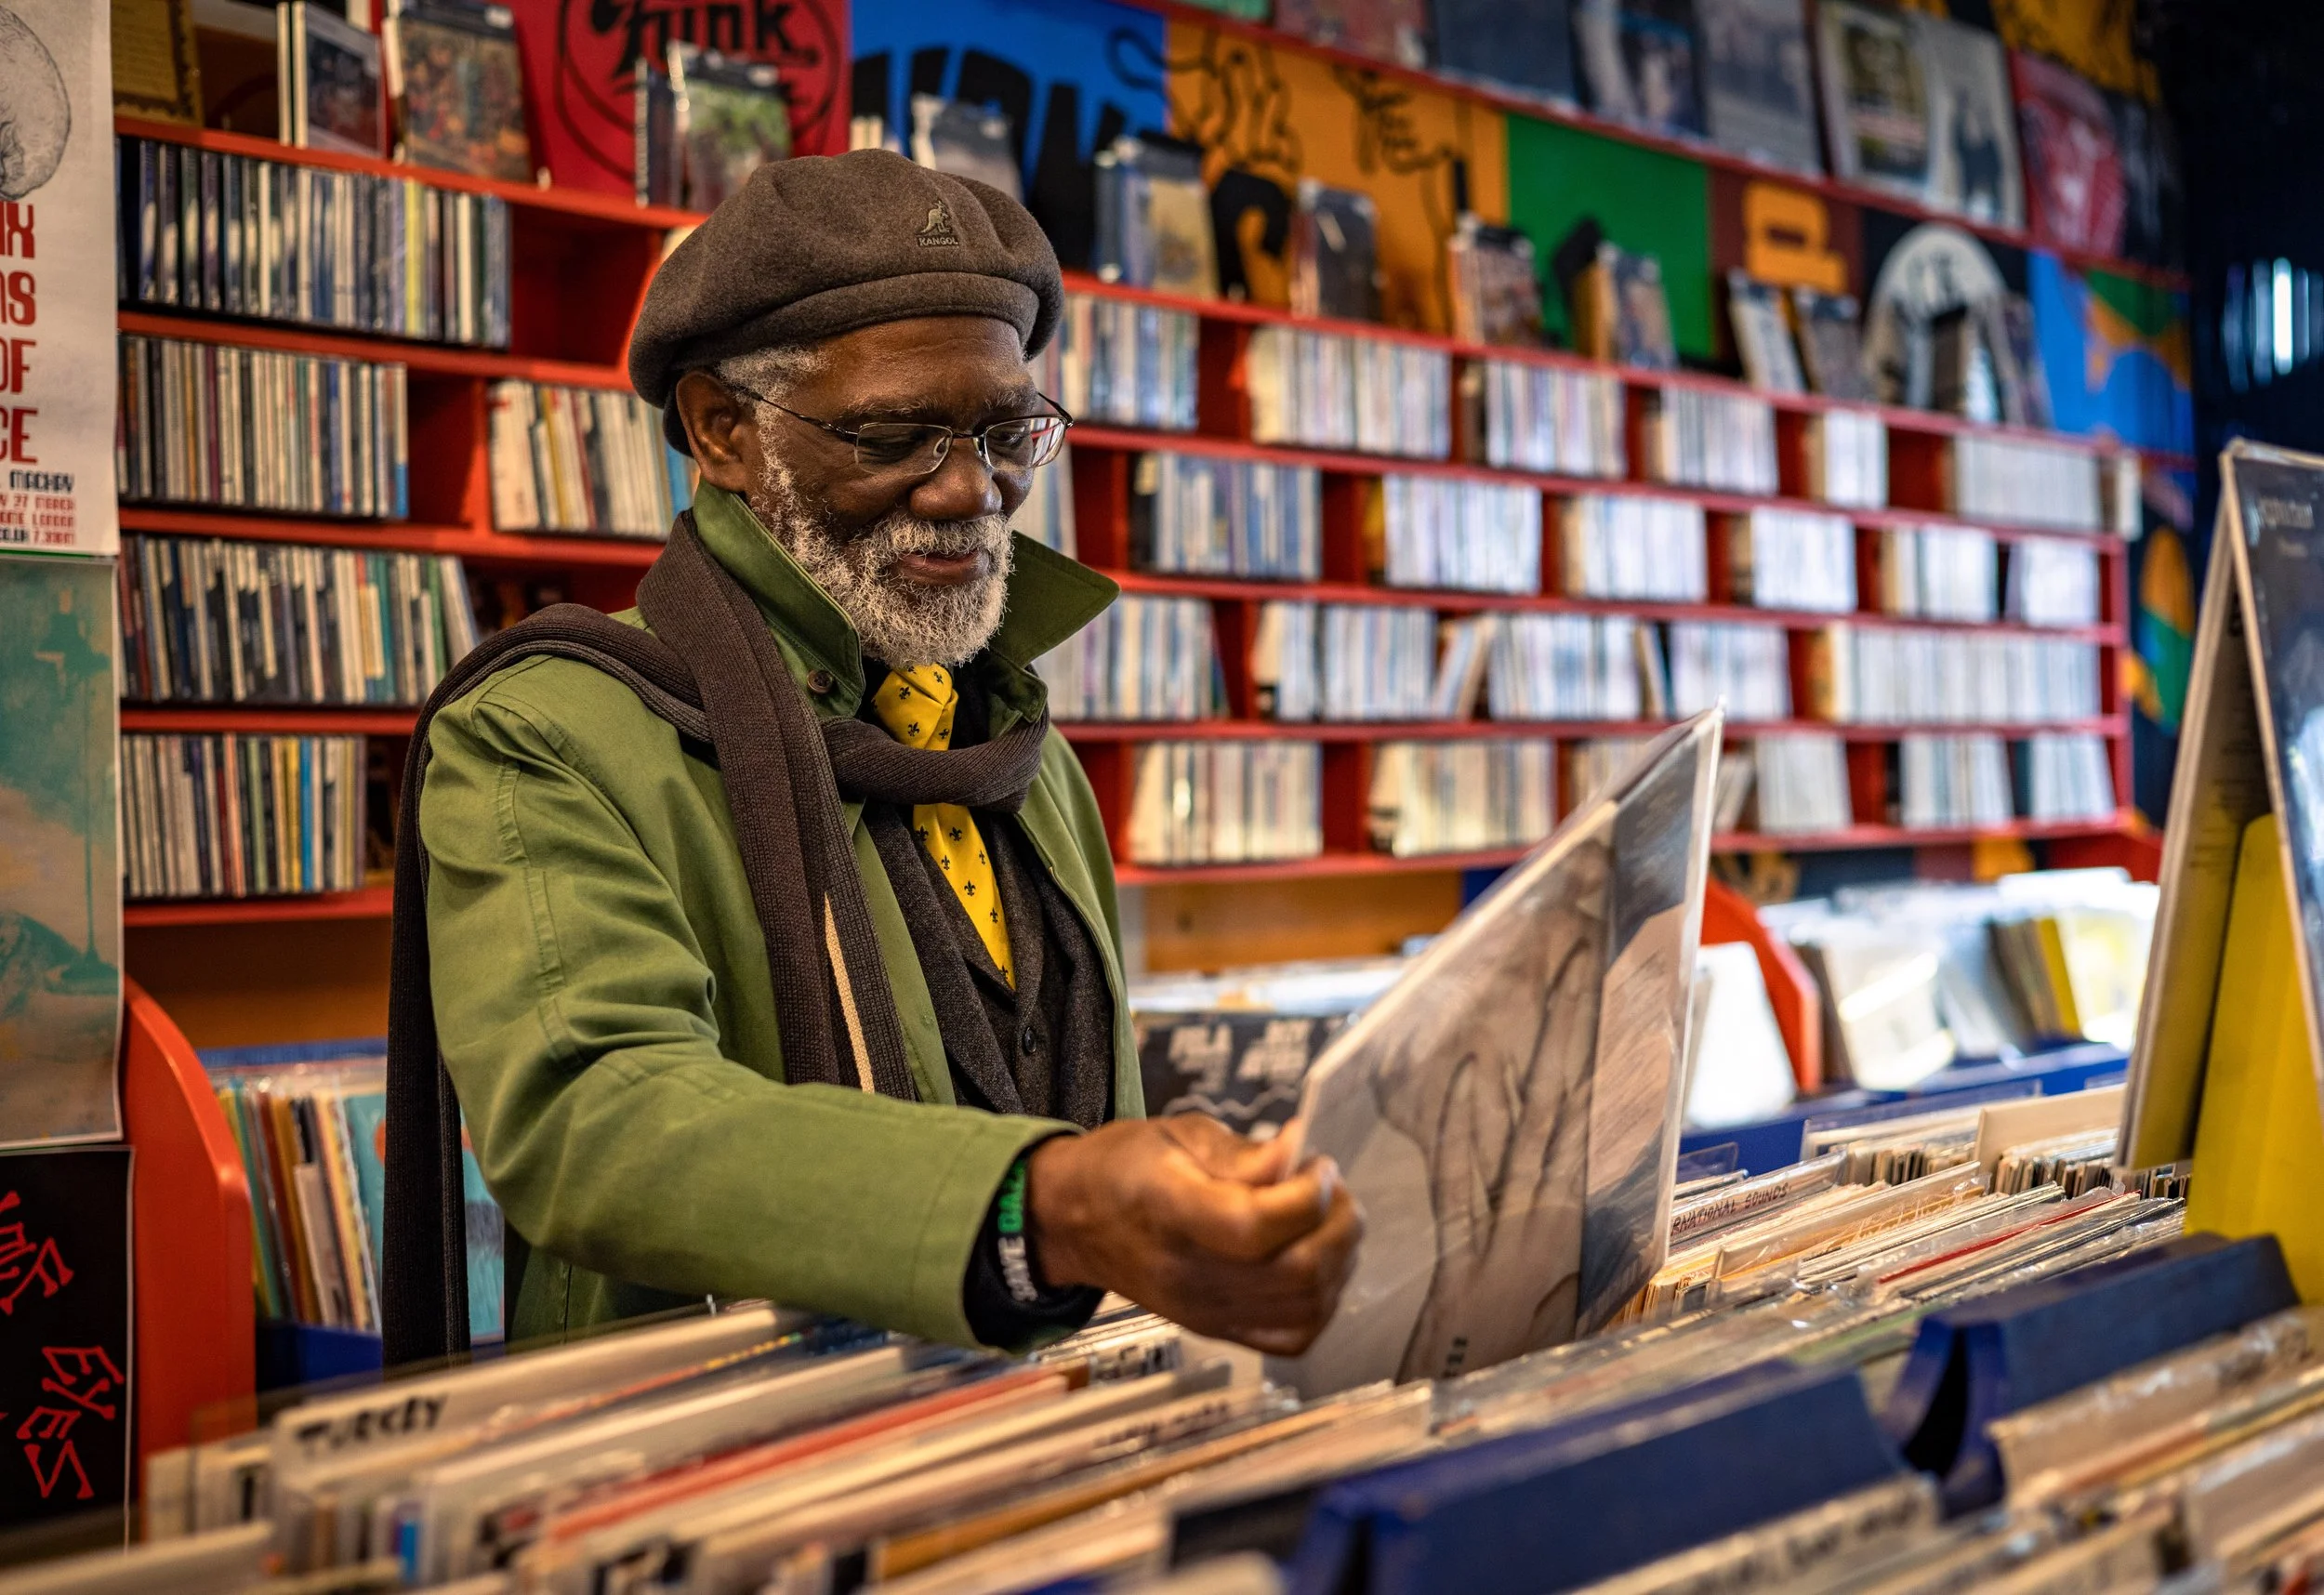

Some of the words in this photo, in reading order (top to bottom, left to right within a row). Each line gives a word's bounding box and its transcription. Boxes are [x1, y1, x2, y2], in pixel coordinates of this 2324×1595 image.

[918, 237, 958, 246] KANGOL
[35, 496, 75, 511] MARCH
[33, 513, 74, 528] LONDON
[1745, 1181, 1789, 1208] SOUNDS
